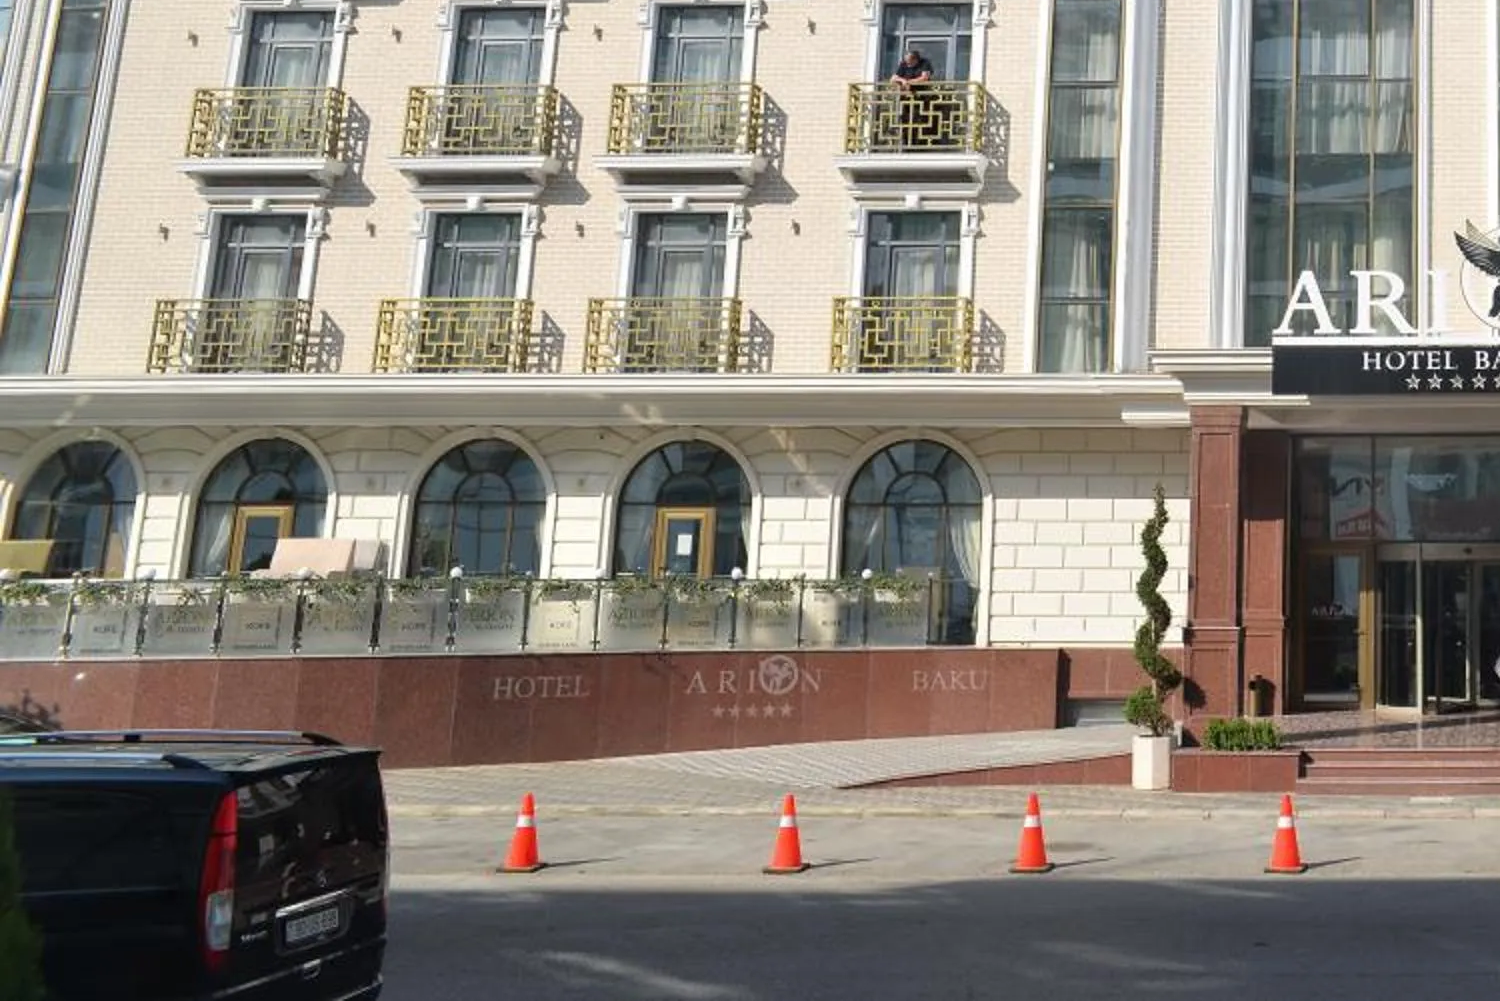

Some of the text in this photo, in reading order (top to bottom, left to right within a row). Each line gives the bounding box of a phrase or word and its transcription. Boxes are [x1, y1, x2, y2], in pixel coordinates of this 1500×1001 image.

[1362, 350, 1459, 372] HOTEL
[493, 654, 988, 700] HOTEL ARION BAKU
